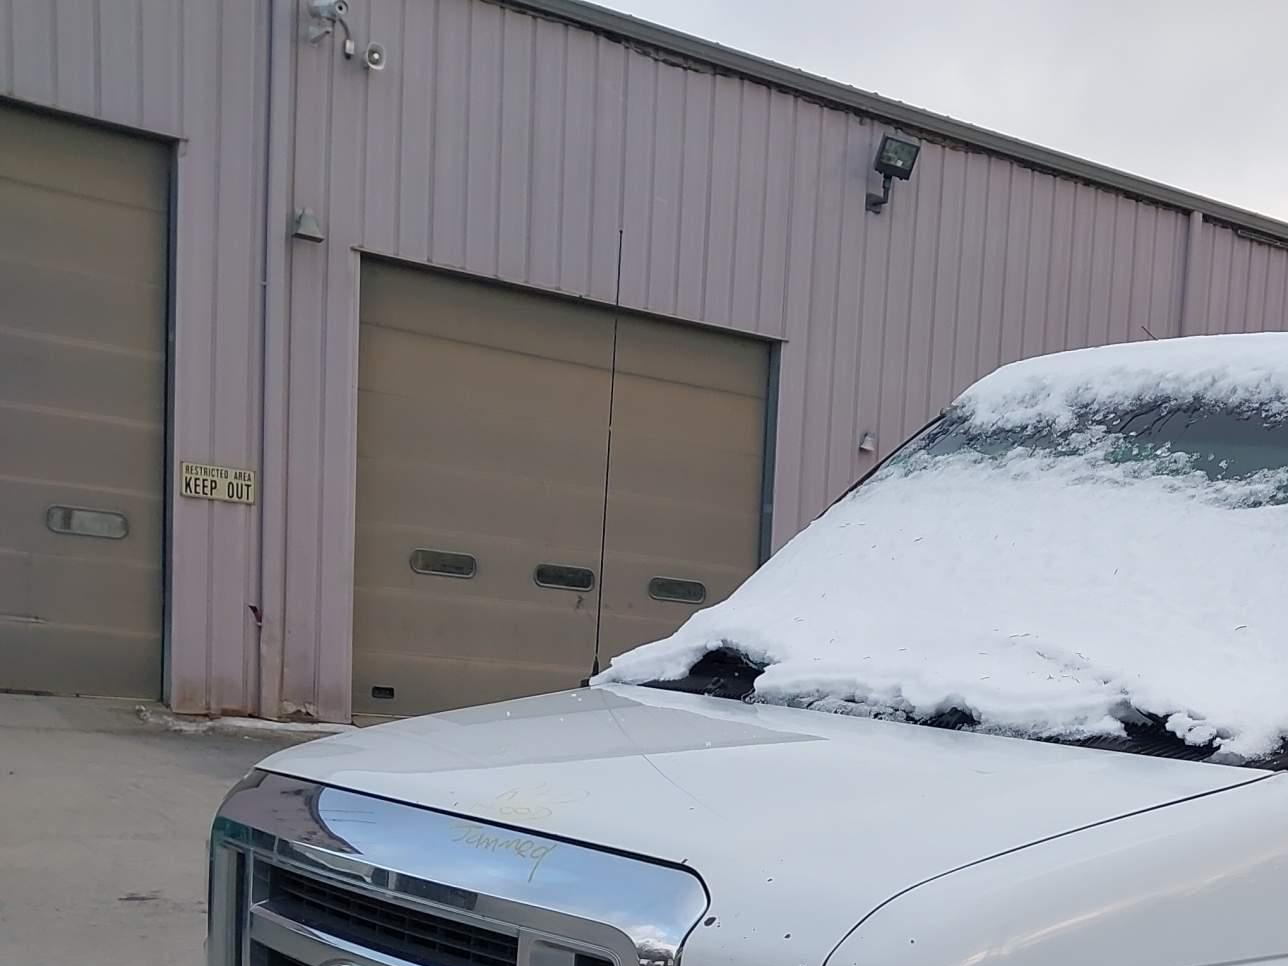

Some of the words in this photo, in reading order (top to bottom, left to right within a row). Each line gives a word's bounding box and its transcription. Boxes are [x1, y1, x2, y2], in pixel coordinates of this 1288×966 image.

[185, 465, 229, 479] RESTRICTED
[233, 471, 252, 482] AREA
[184, 476, 217, 496] KEEP
[227, 481, 252, 500] OUT
